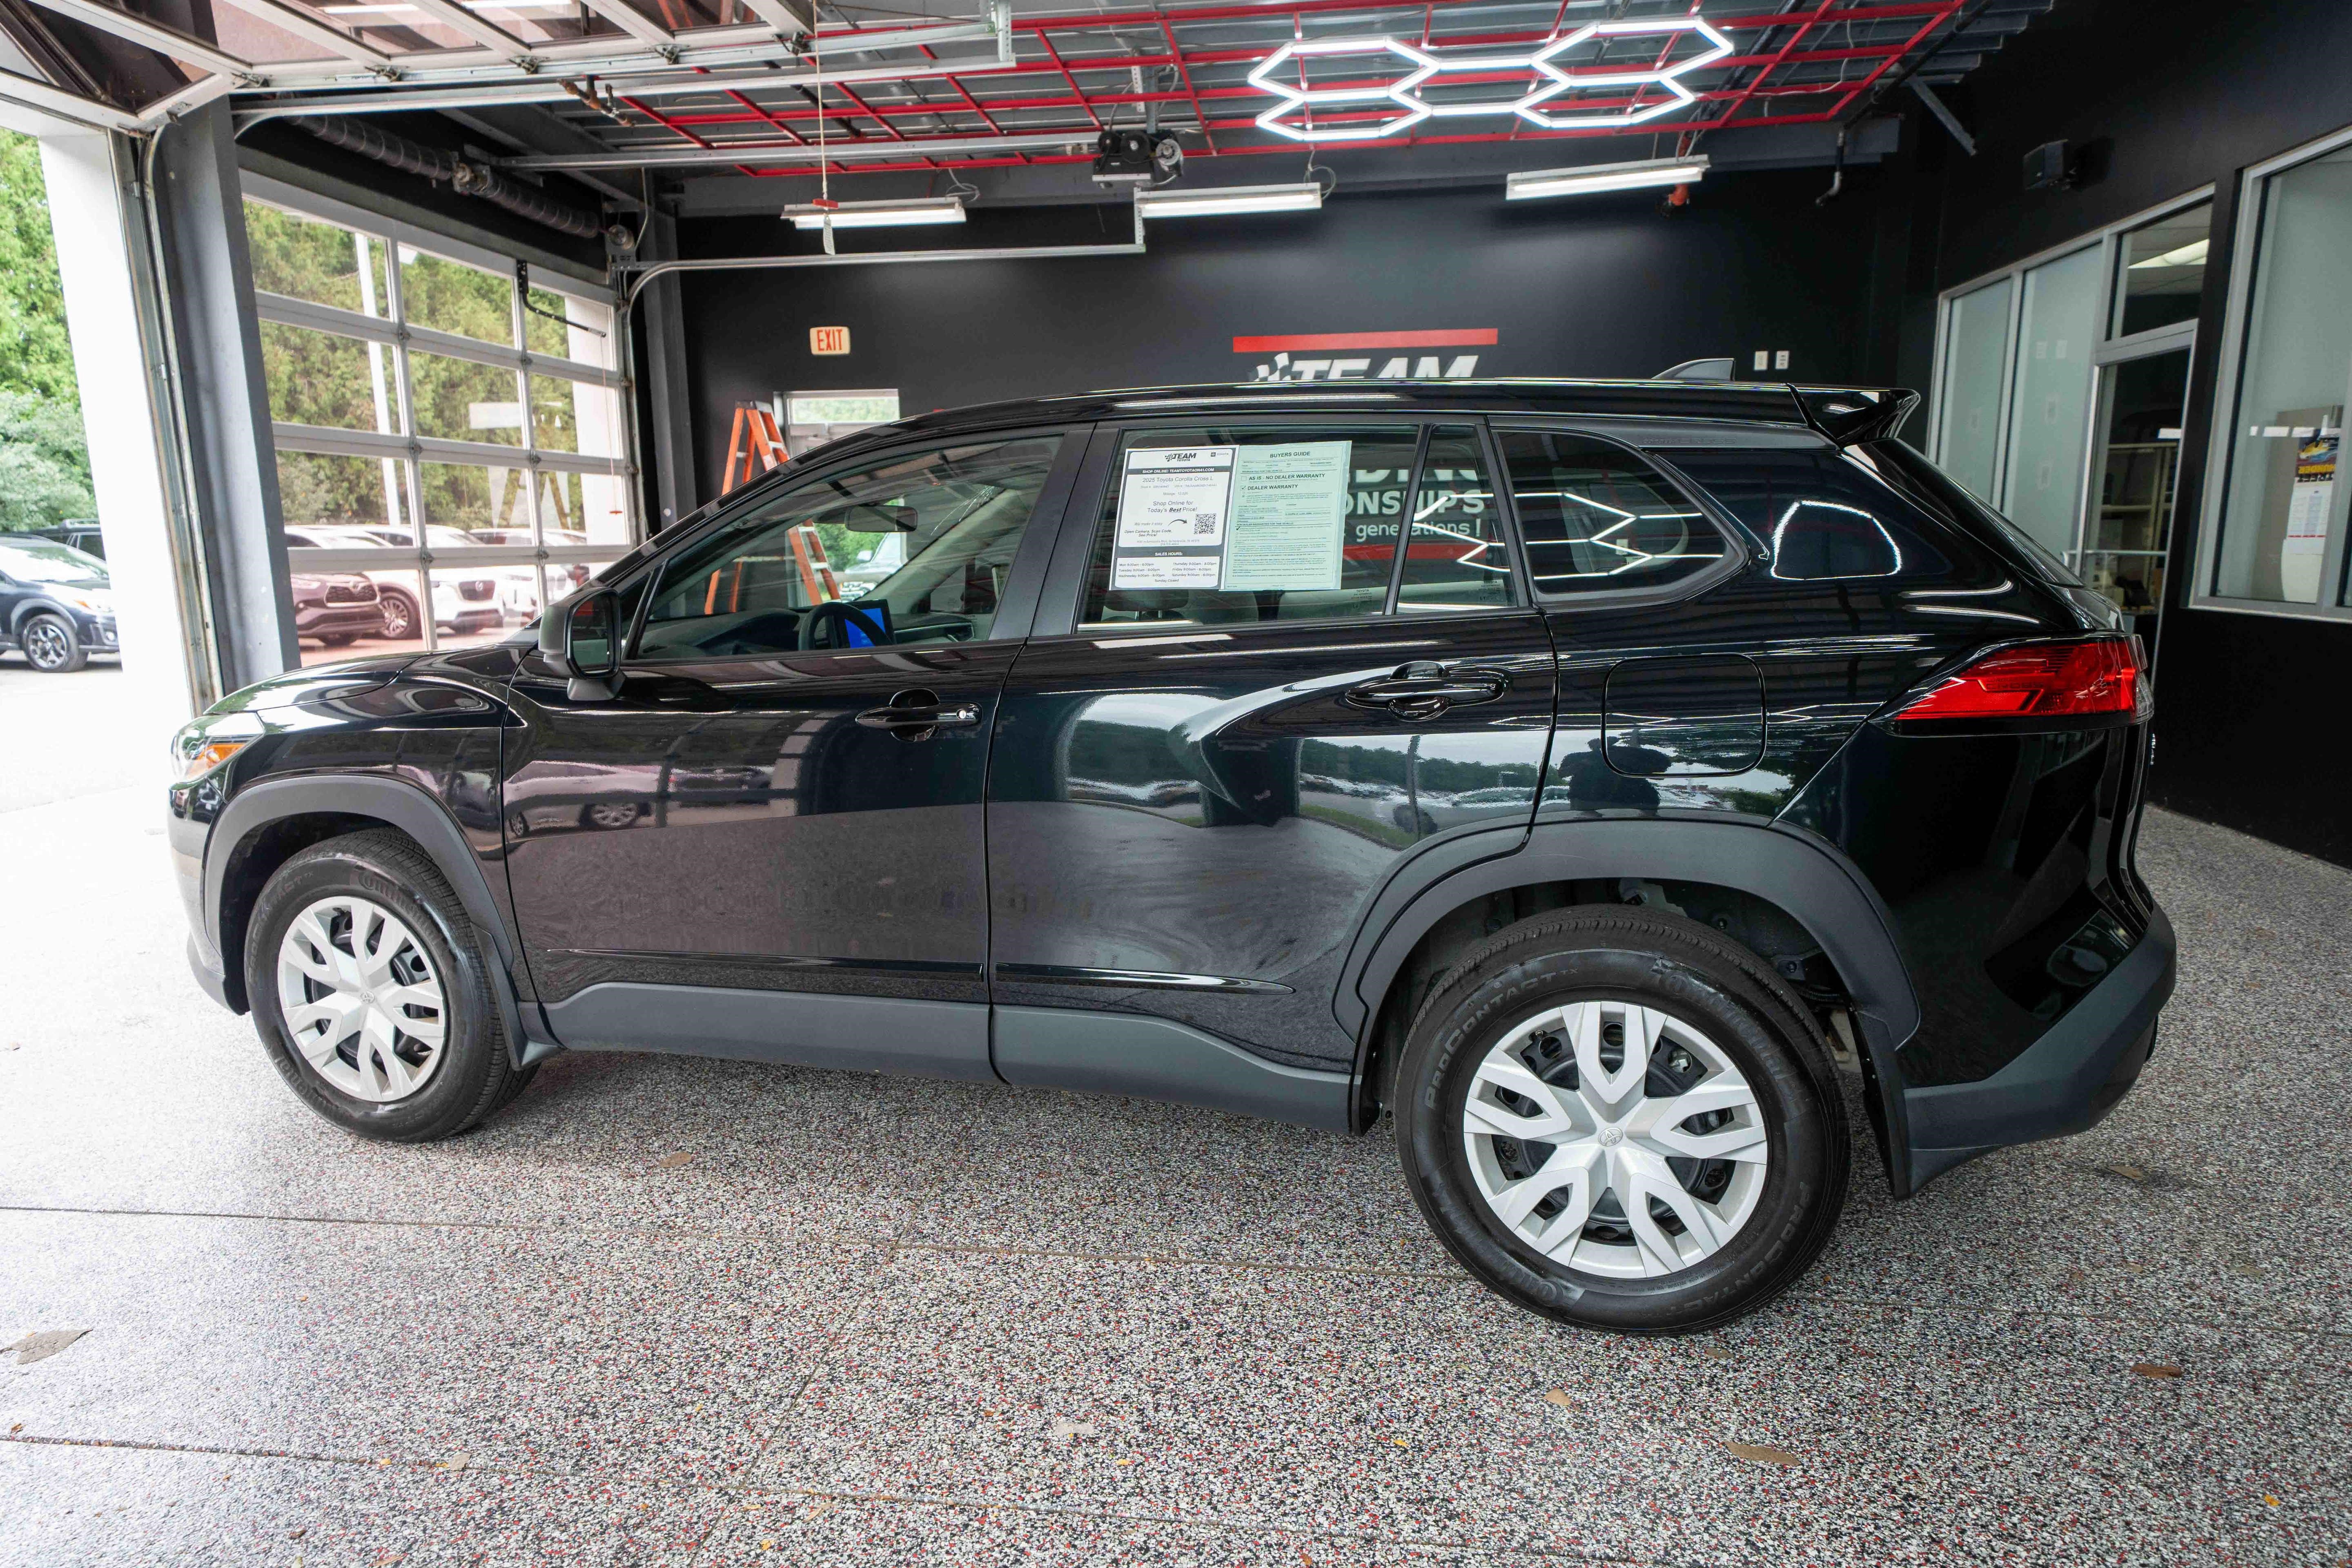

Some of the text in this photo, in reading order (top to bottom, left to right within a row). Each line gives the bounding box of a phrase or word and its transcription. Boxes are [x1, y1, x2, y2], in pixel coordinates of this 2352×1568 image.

[817, 329, 843, 351] EXIT
[1356, 518, 1481, 542] geneations!
[1424, 972, 1557, 1110] PROCONTACT
[1560, 967, 1579, 976] TX
